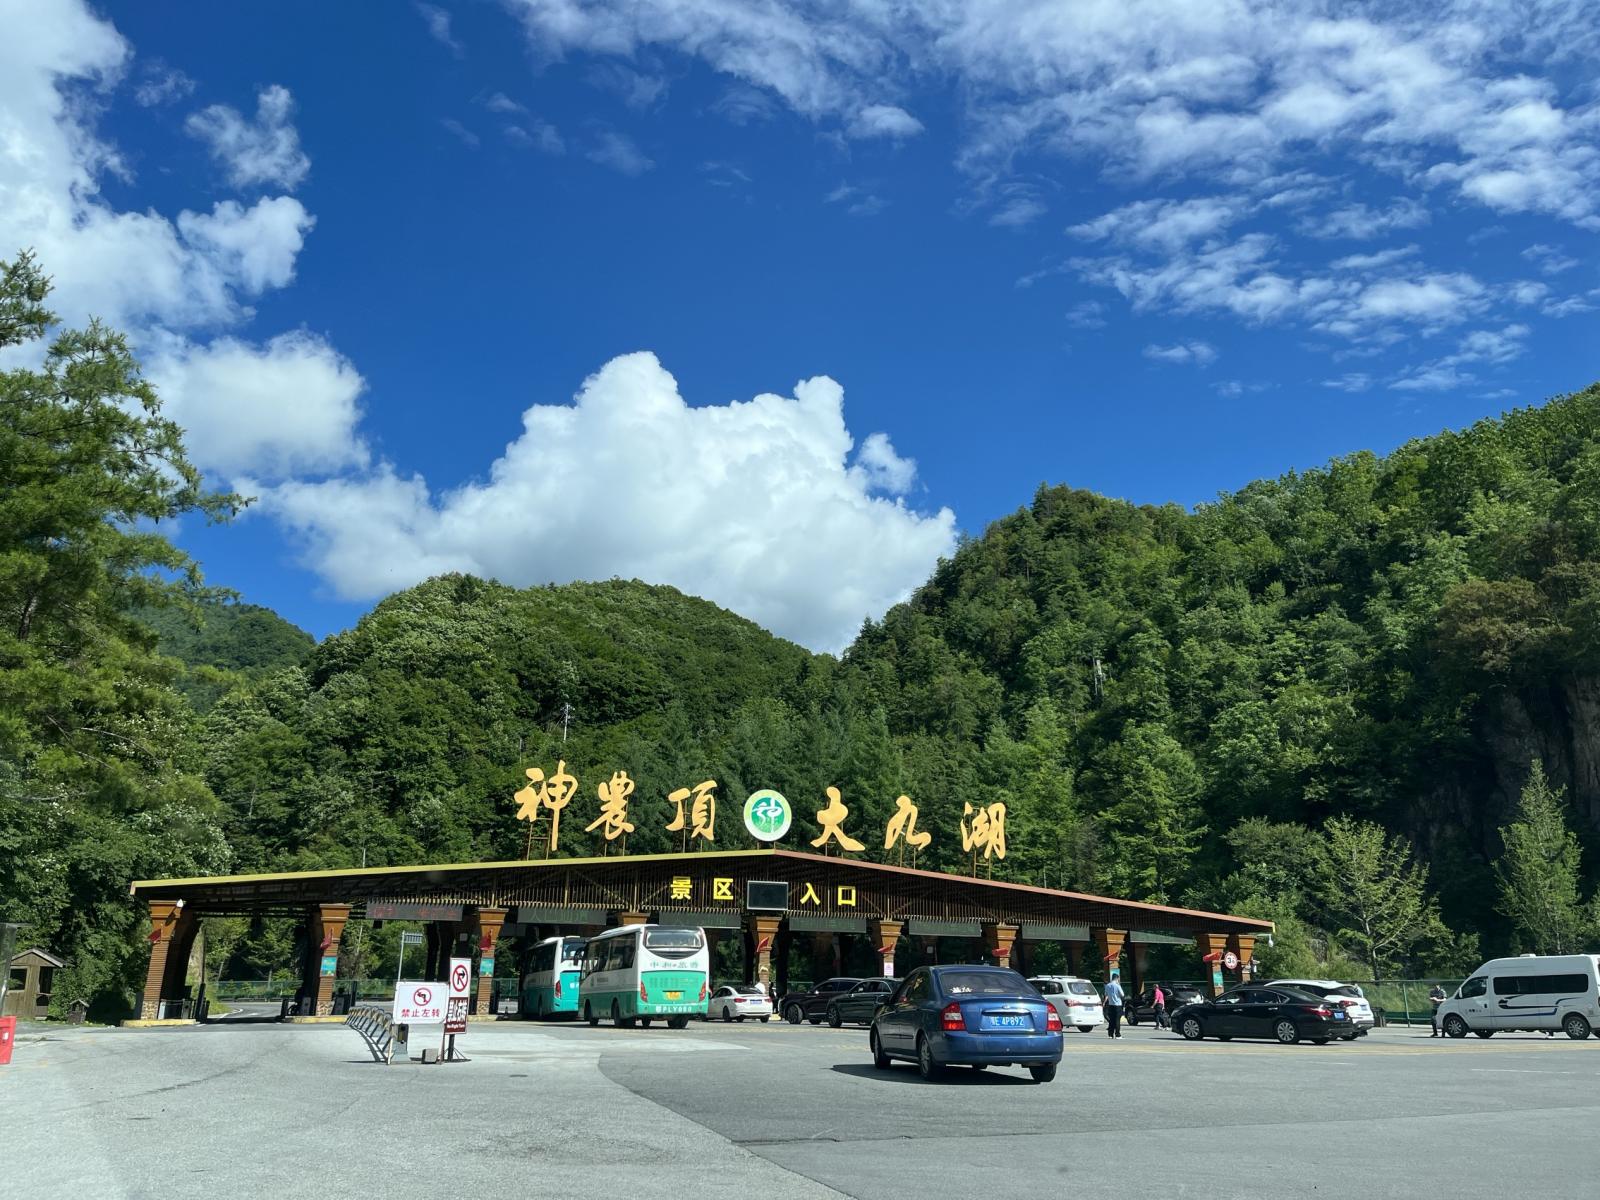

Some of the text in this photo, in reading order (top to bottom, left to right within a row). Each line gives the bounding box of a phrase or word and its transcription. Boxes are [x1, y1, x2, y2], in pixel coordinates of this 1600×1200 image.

[810, 786, 1006, 860] 大九湖
[671, 876, 856, 906] 景区 入口
[401, 1009, 441, 1018] 禁止左转
